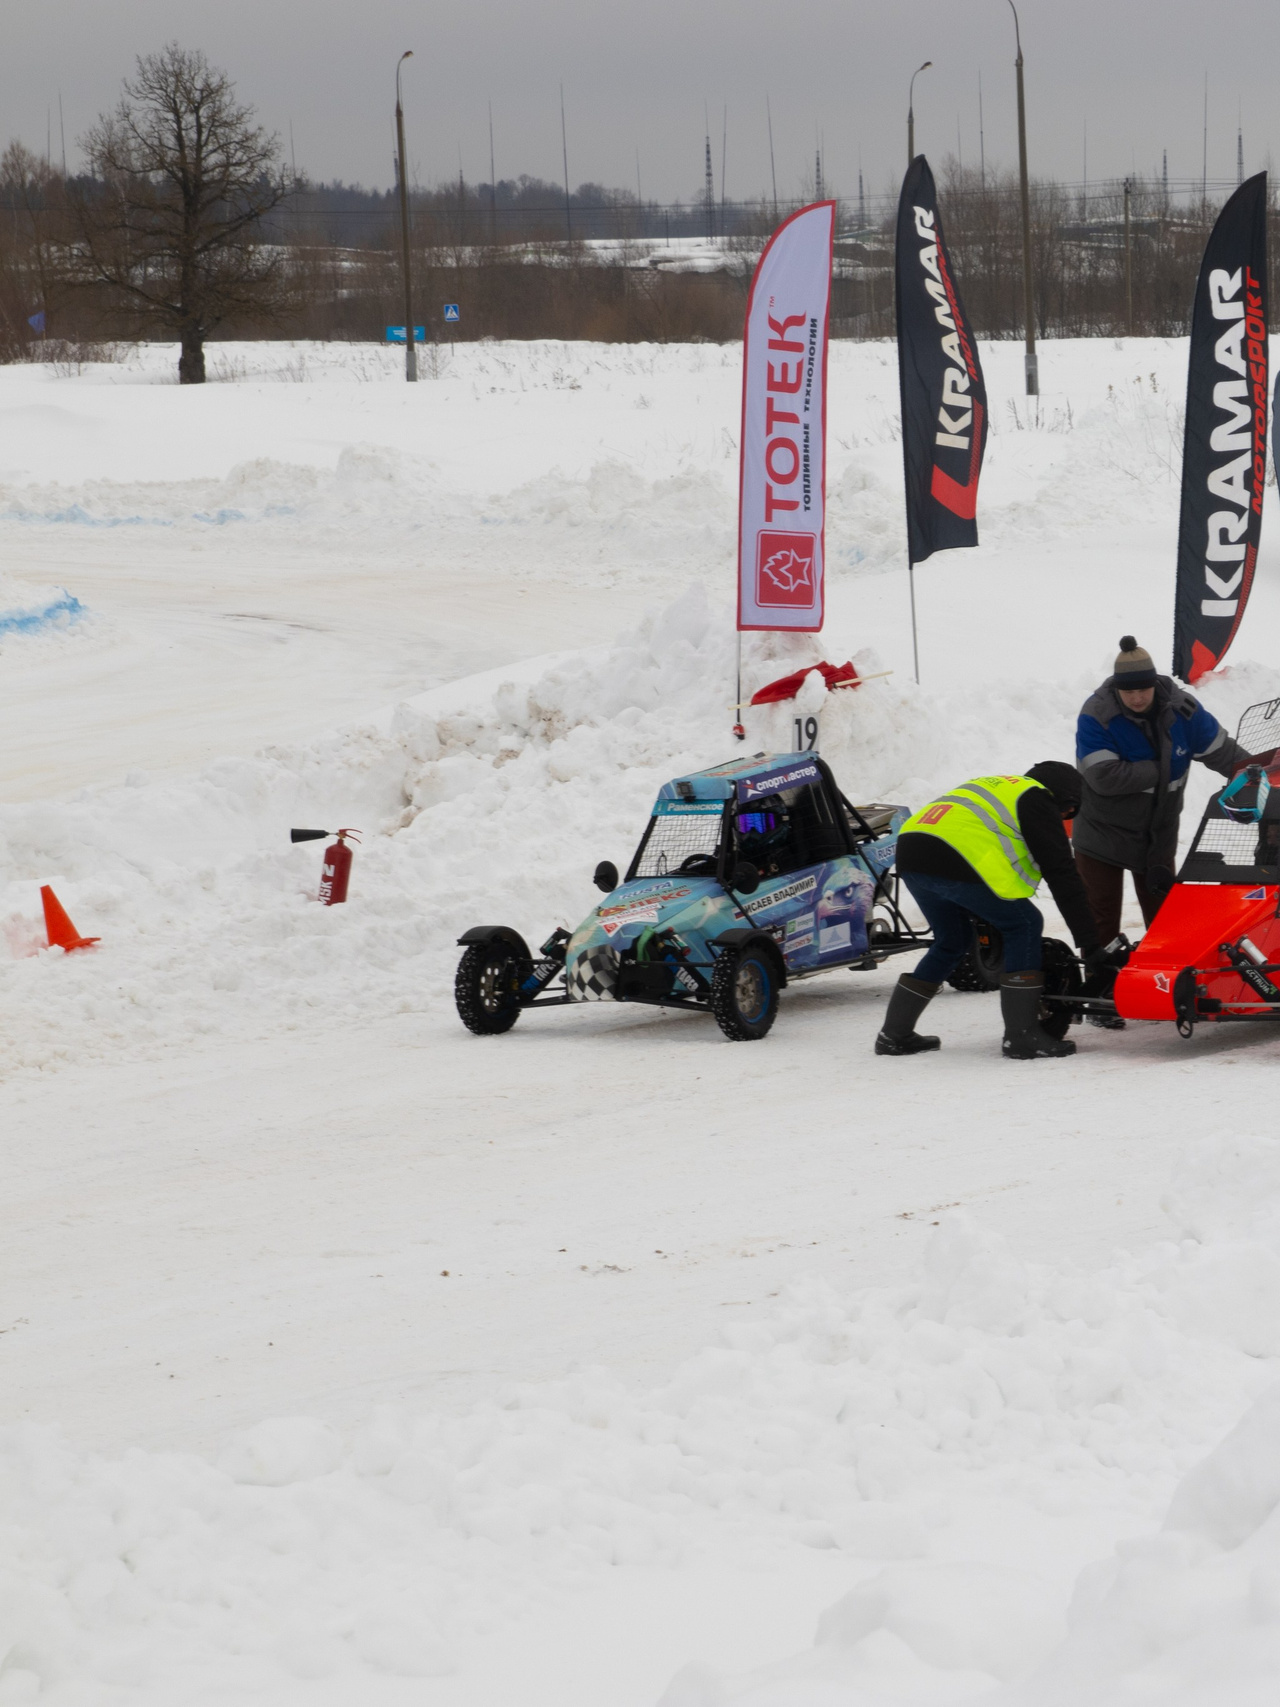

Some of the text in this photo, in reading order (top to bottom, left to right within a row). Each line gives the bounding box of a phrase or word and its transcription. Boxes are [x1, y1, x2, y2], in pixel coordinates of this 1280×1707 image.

[765, 309, 807, 522] ТОТЕК
[803, 318, 818, 512] ТОПЛИВНЫЕ ТЕХНОЛОГИИ
[913, 206, 972, 450] KRAMAR
[1201, 266, 1252, 617] KRAMAR
[667, 802, 724, 812] Раменское
[794, 716, 818, 751] 19
[774, 877, 816, 903] ВЛАДИМИР
